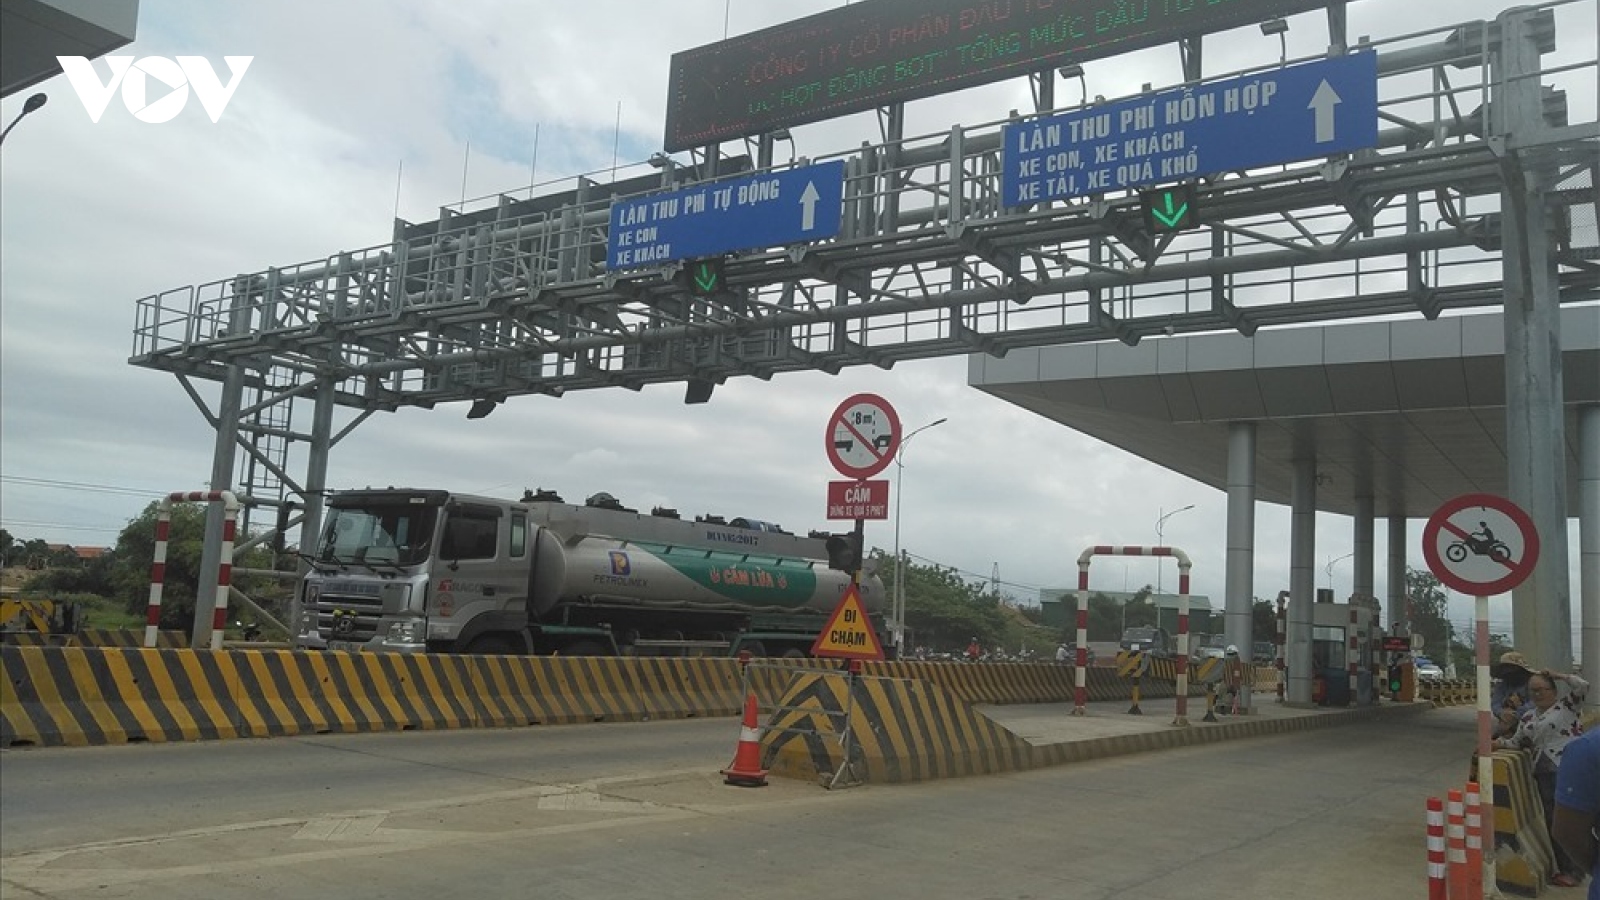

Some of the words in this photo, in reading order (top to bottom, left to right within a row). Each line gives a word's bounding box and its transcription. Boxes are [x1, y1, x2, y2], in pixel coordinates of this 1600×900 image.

[1018, 124, 1060, 153] LÀN
[1069, 113, 1111, 143] THU
[1120, 100, 1155, 133] PHÍ
[1165, 87, 1215, 125] HỖN
[1224, 80, 1278, 115] HỢP
[1018, 157, 1041, 178] XE
[1046, 150, 1085, 171] CON,
[1095, 142, 1122, 165] XE
[1124, 131, 1185, 159] KHÁCH
[1018, 181, 1040, 201] XE
[1087, 168, 1110, 189] XE
[1117, 157, 1153, 186] QUÁ
[1161, 145, 1198, 177] KHỔ
[619, 203, 647, 226] LÀN
[652, 198, 679, 221] THU
[684, 188, 706, 214] PHÍ
[713, 185, 733, 211] TỰ
[738, 179, 780, 206] ĐỘNG
[618, 230, 633, 247] XE
[635, 226, 658, 244] CON
[616, 250, 631, 266] XE
[633, 243, 671, 264] KHÁCH
[844, 481, 872, 504] CẤM
[844, 609, 857, 624] ĐI
[830, 627, 867, 648] CHẬM
